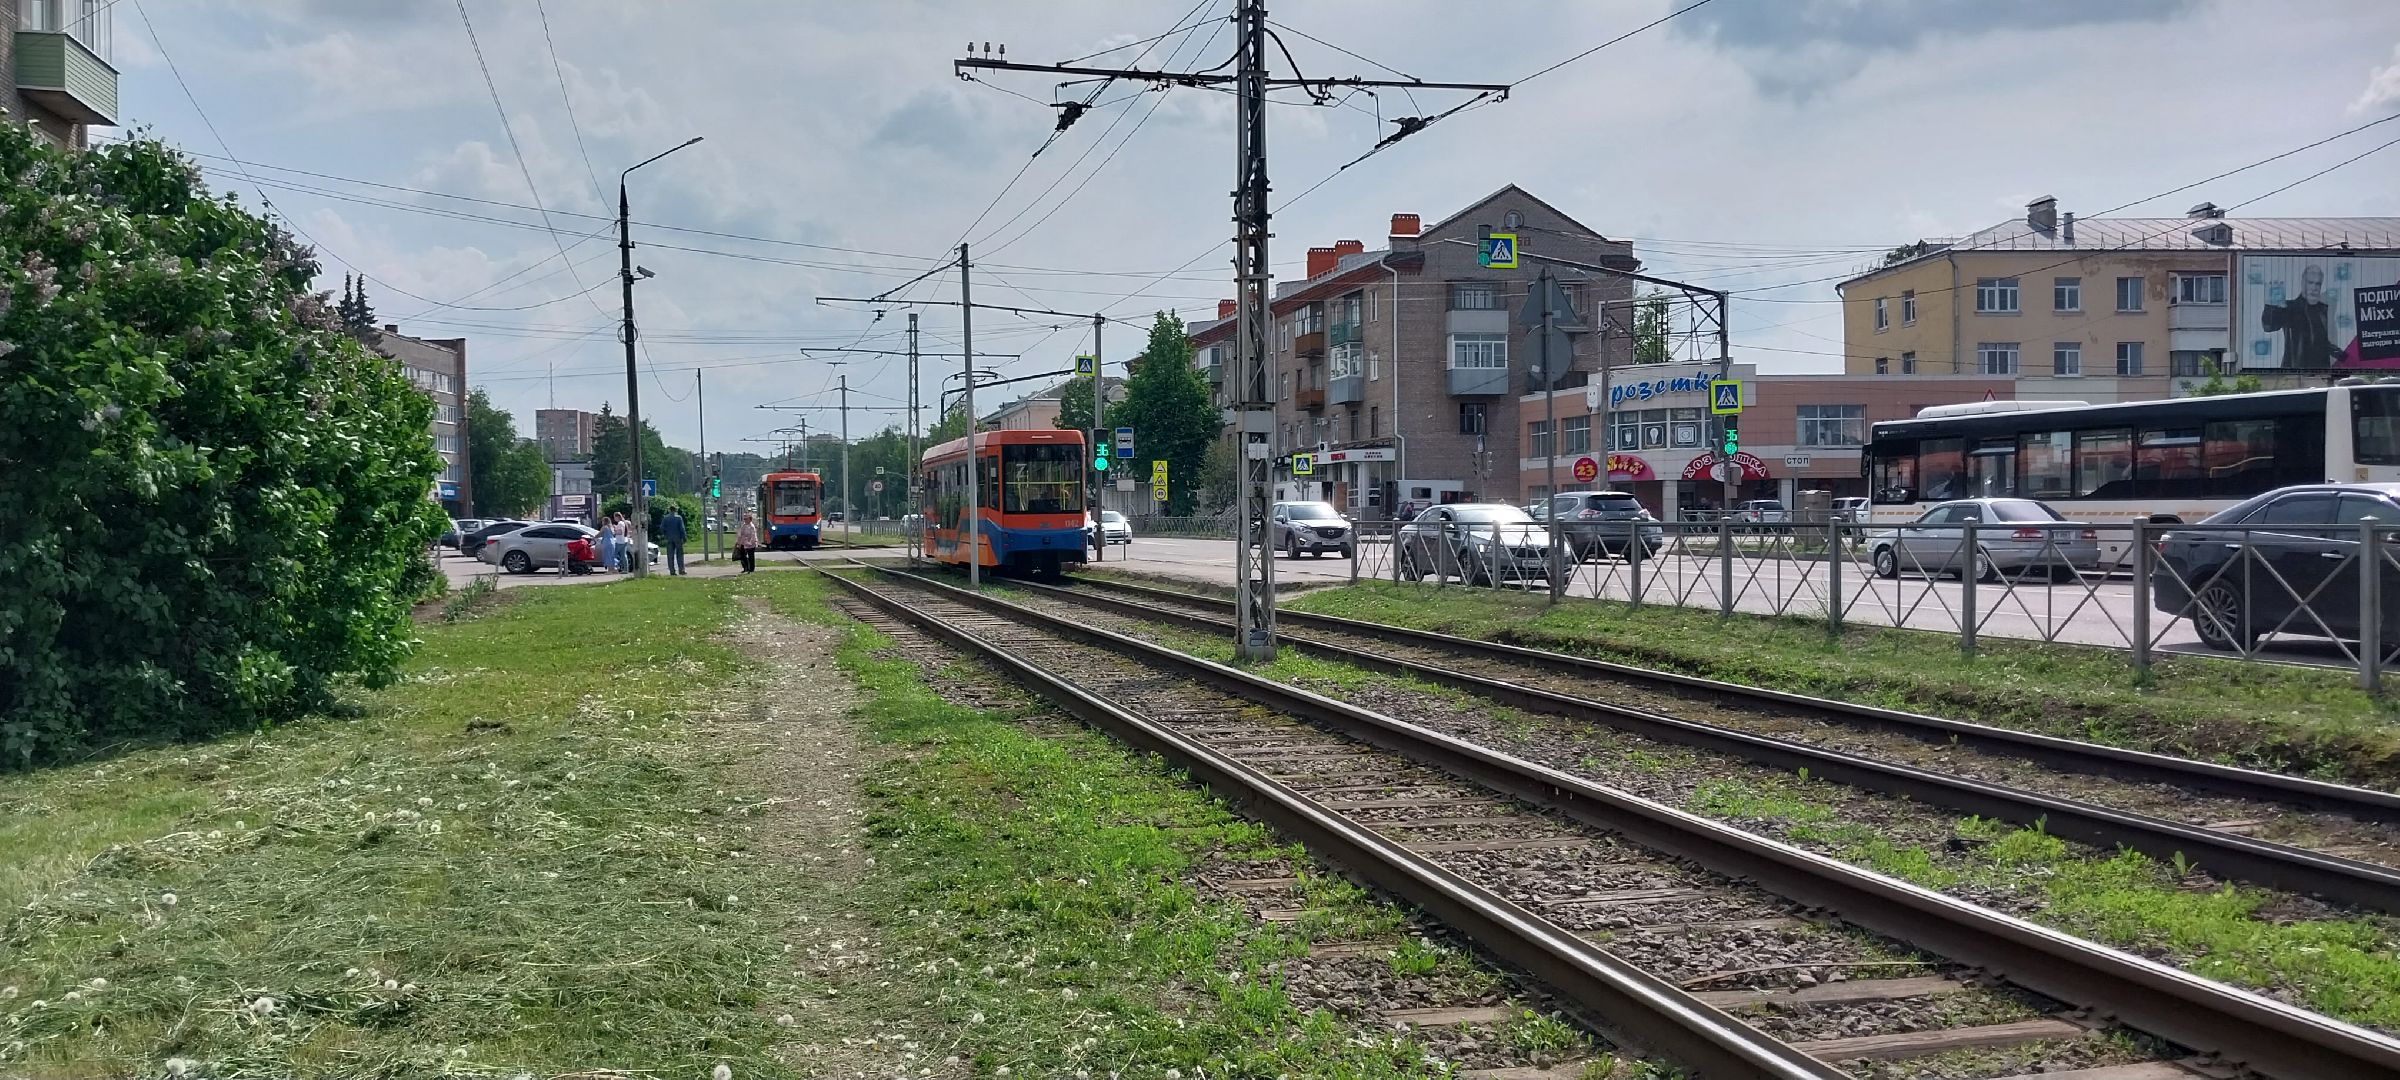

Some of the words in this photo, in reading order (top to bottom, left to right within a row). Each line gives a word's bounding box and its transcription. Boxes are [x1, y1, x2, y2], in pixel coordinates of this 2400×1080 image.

[2361, 307, 2394, 321] Mixx
[1726, 429, 1738, 441] 36
[1096, 443, 1109, 456] 36
[1786, 457, 1809, 465] СТОП
[1576, 465, 1596, 476] 23
